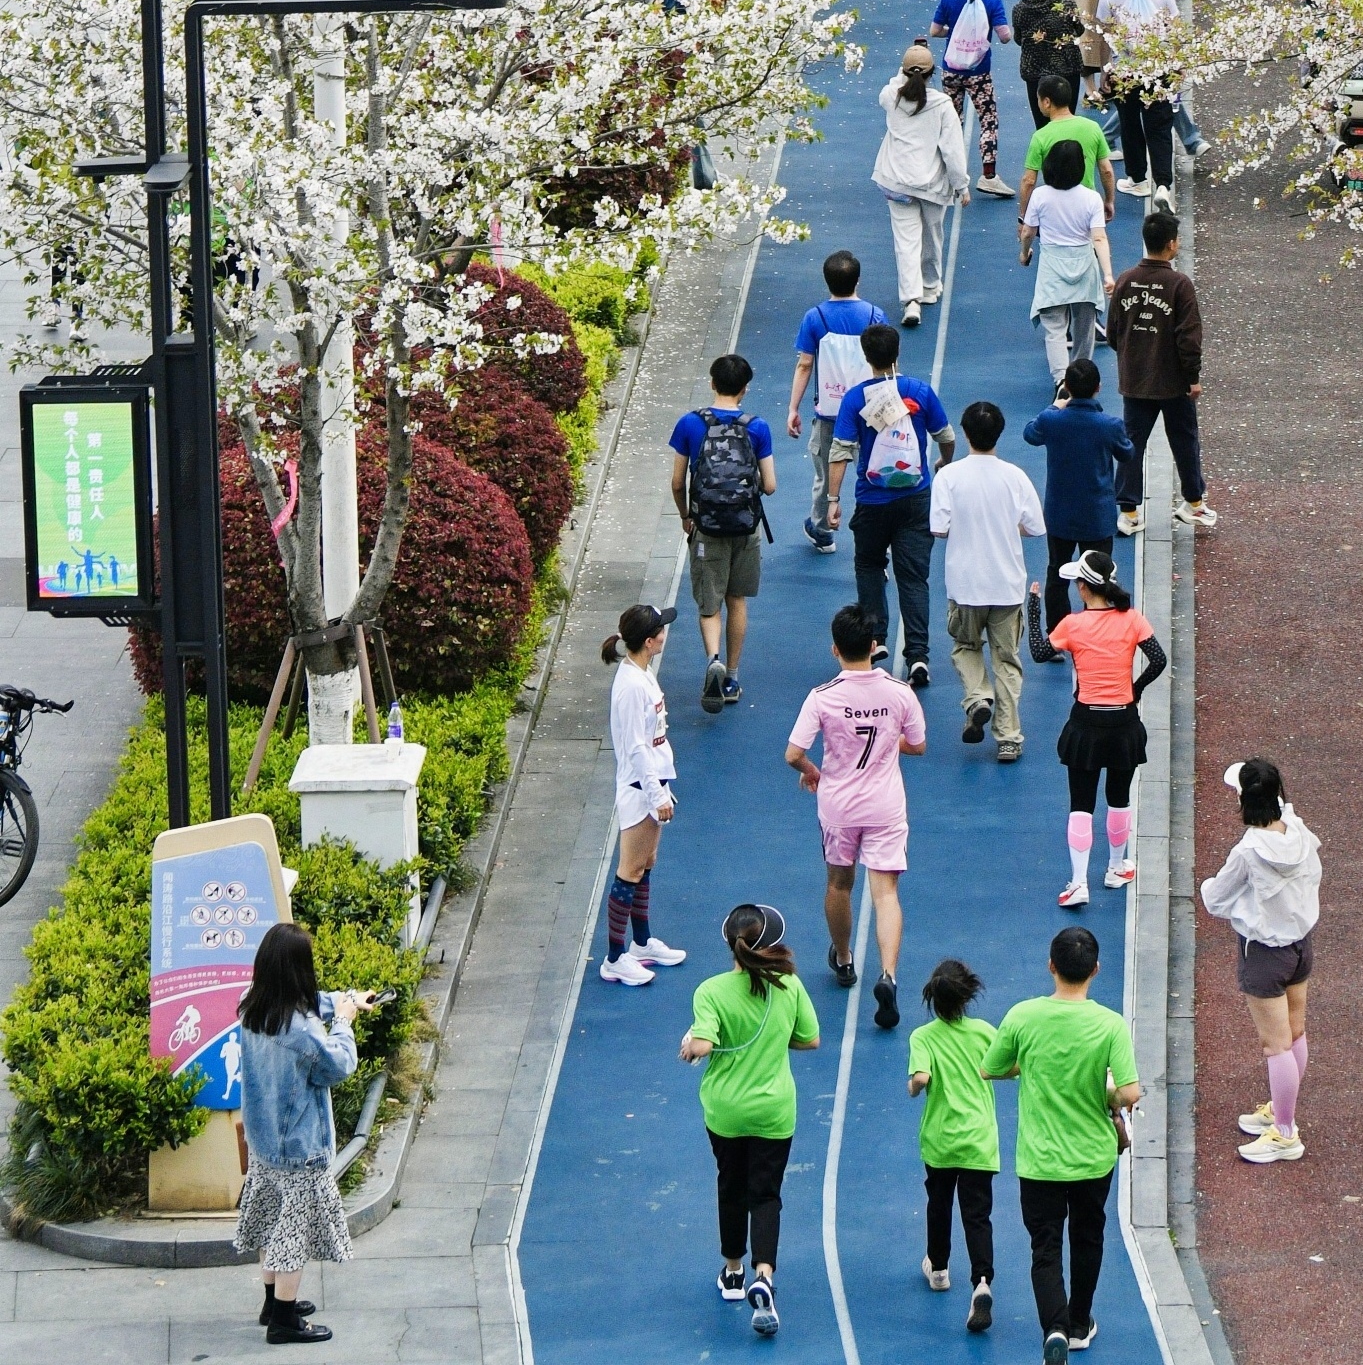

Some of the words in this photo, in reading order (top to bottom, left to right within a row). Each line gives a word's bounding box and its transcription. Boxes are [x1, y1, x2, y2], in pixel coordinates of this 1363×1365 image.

[1121, 296, 1139, 312] Lee
[1141, 291, 1173, 316] Jeans
[87, 433, 105, 520] 第一责任人
[844, 707, 888, 719] Seven
[855, 726, 877, 769] 7
